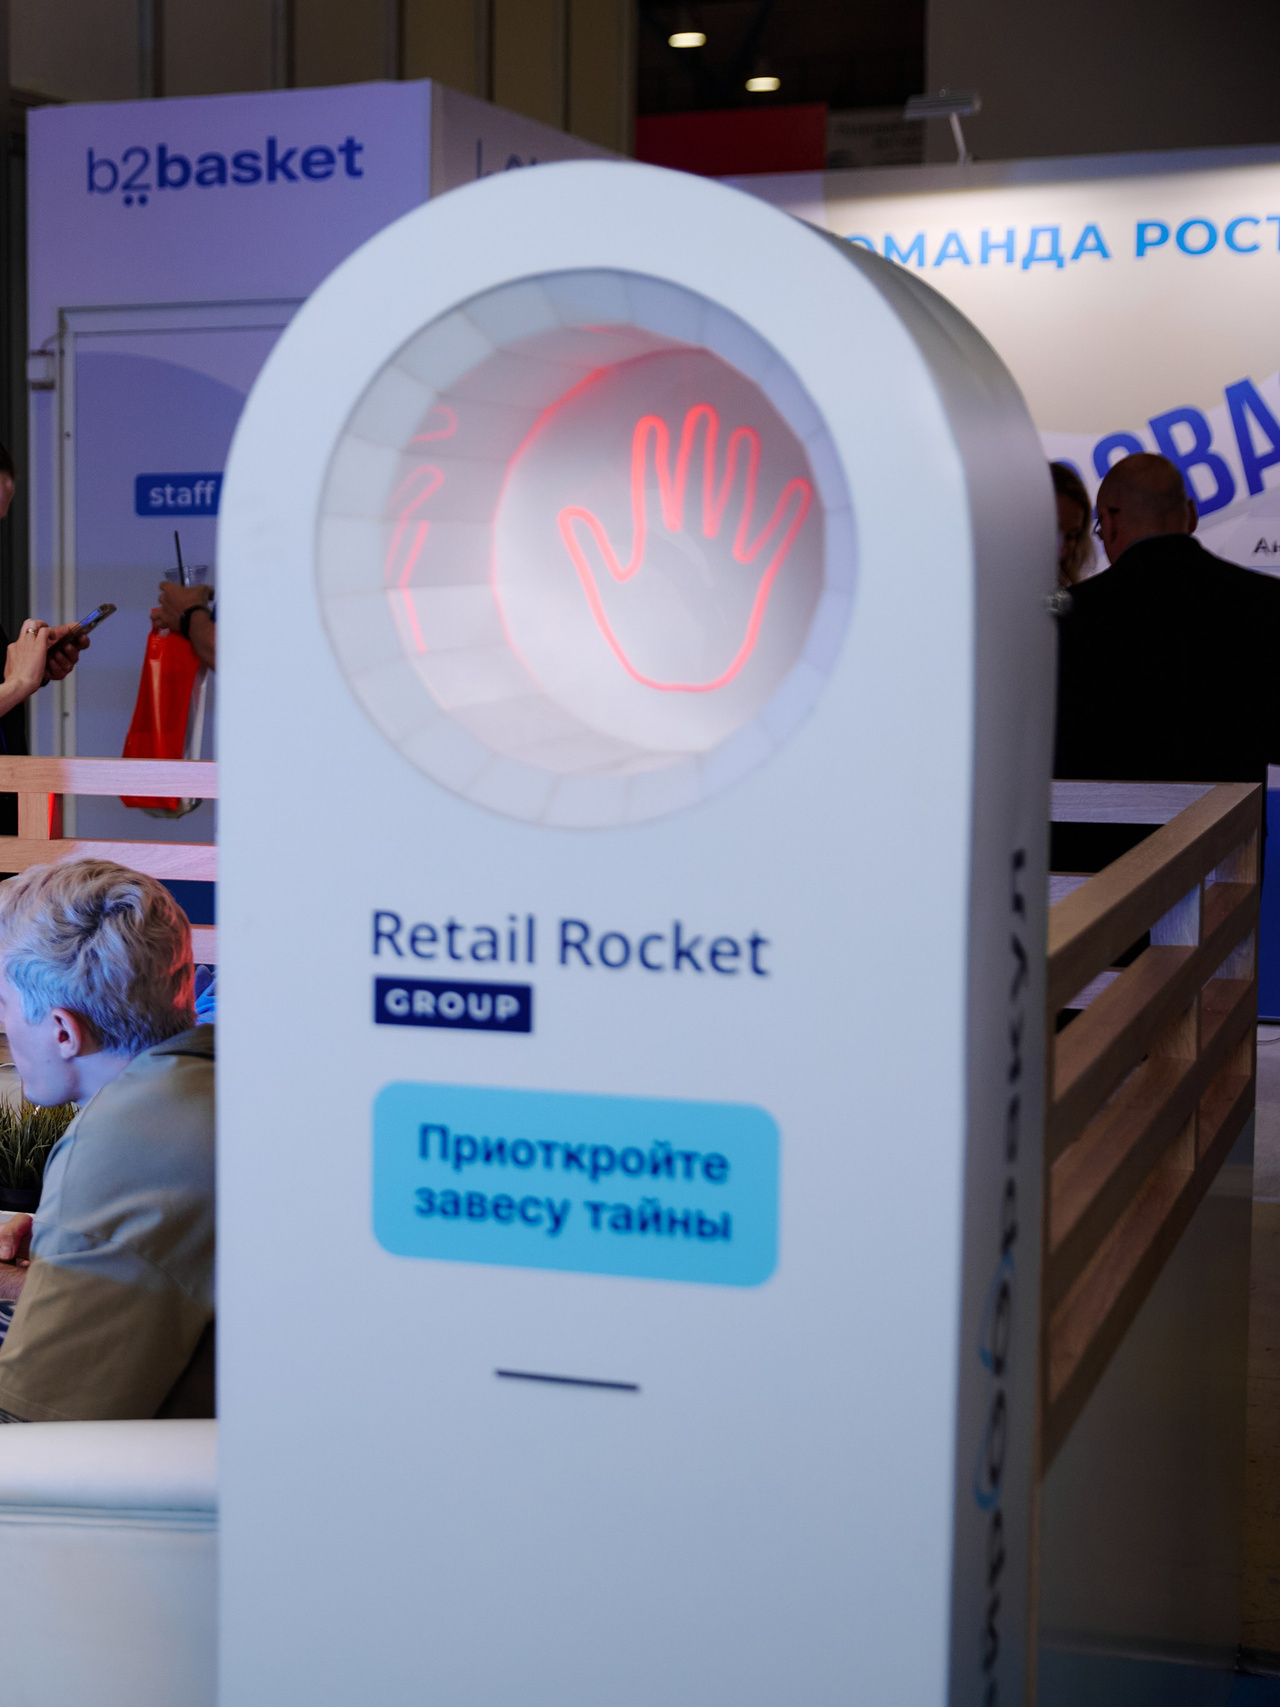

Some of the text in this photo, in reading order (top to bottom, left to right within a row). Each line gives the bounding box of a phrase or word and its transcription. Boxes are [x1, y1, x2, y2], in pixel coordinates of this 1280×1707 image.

[86, 135, 365, 207] b2basket
[149, 479, 217, 508] staff
[371, 908, 770, 976] Retail Rocket
[384, 987, 522, 1023] GROUP
[417, 1121, 731, 1186] Приоткройте
[414, 1185, 733, 1243] завесу тайны
